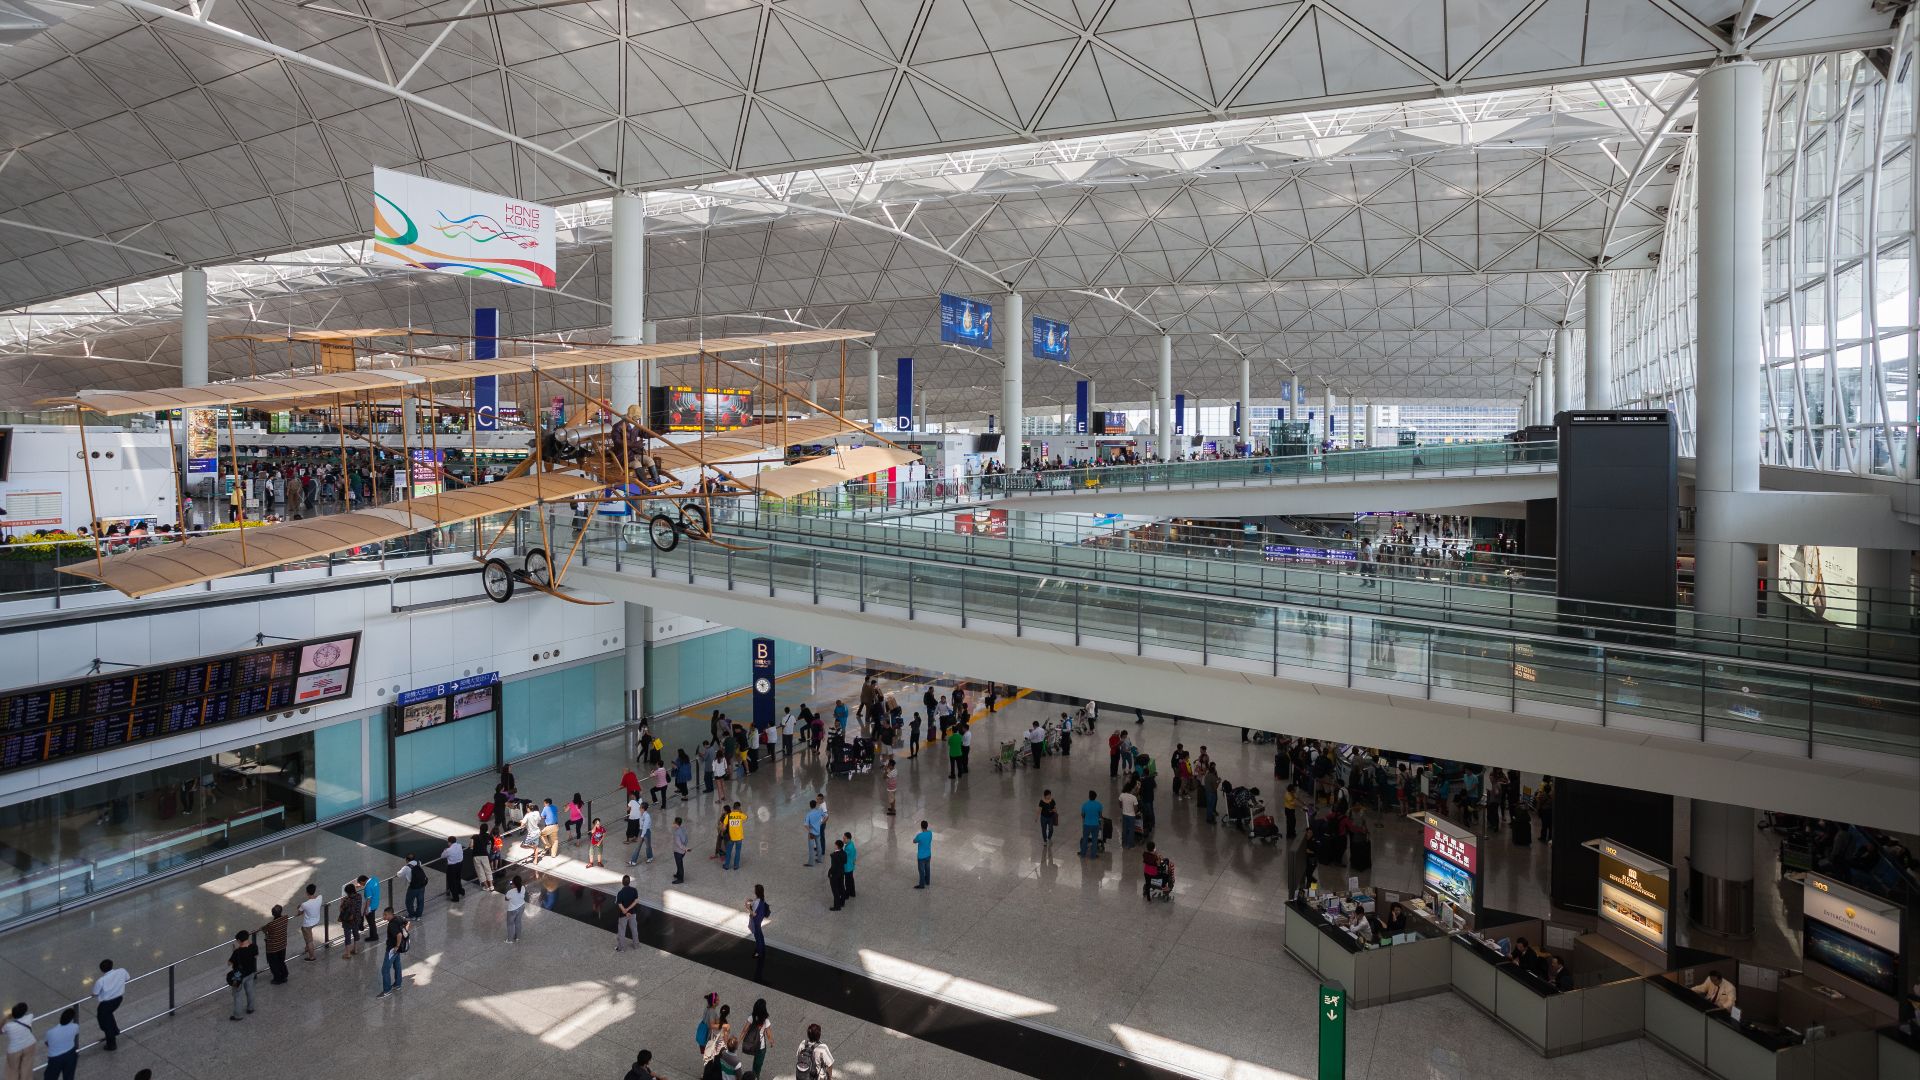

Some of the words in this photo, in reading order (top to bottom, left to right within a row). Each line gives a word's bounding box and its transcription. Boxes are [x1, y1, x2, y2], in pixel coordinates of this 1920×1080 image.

[505, 202, 540, 219] HONG
[505, 213, 540, 229] KONG
[478, 405, 493, 426] C
[899, 416, 910, 429] D
[1078, 422, 1085, 432] E
[1176, 426, 1183, 434] F
[757, 643, 768, 659] B
[490, 672, 499, 684] A
[437, 684, 445, 696] B
[1621, 874, 1642, 889] REGAL
